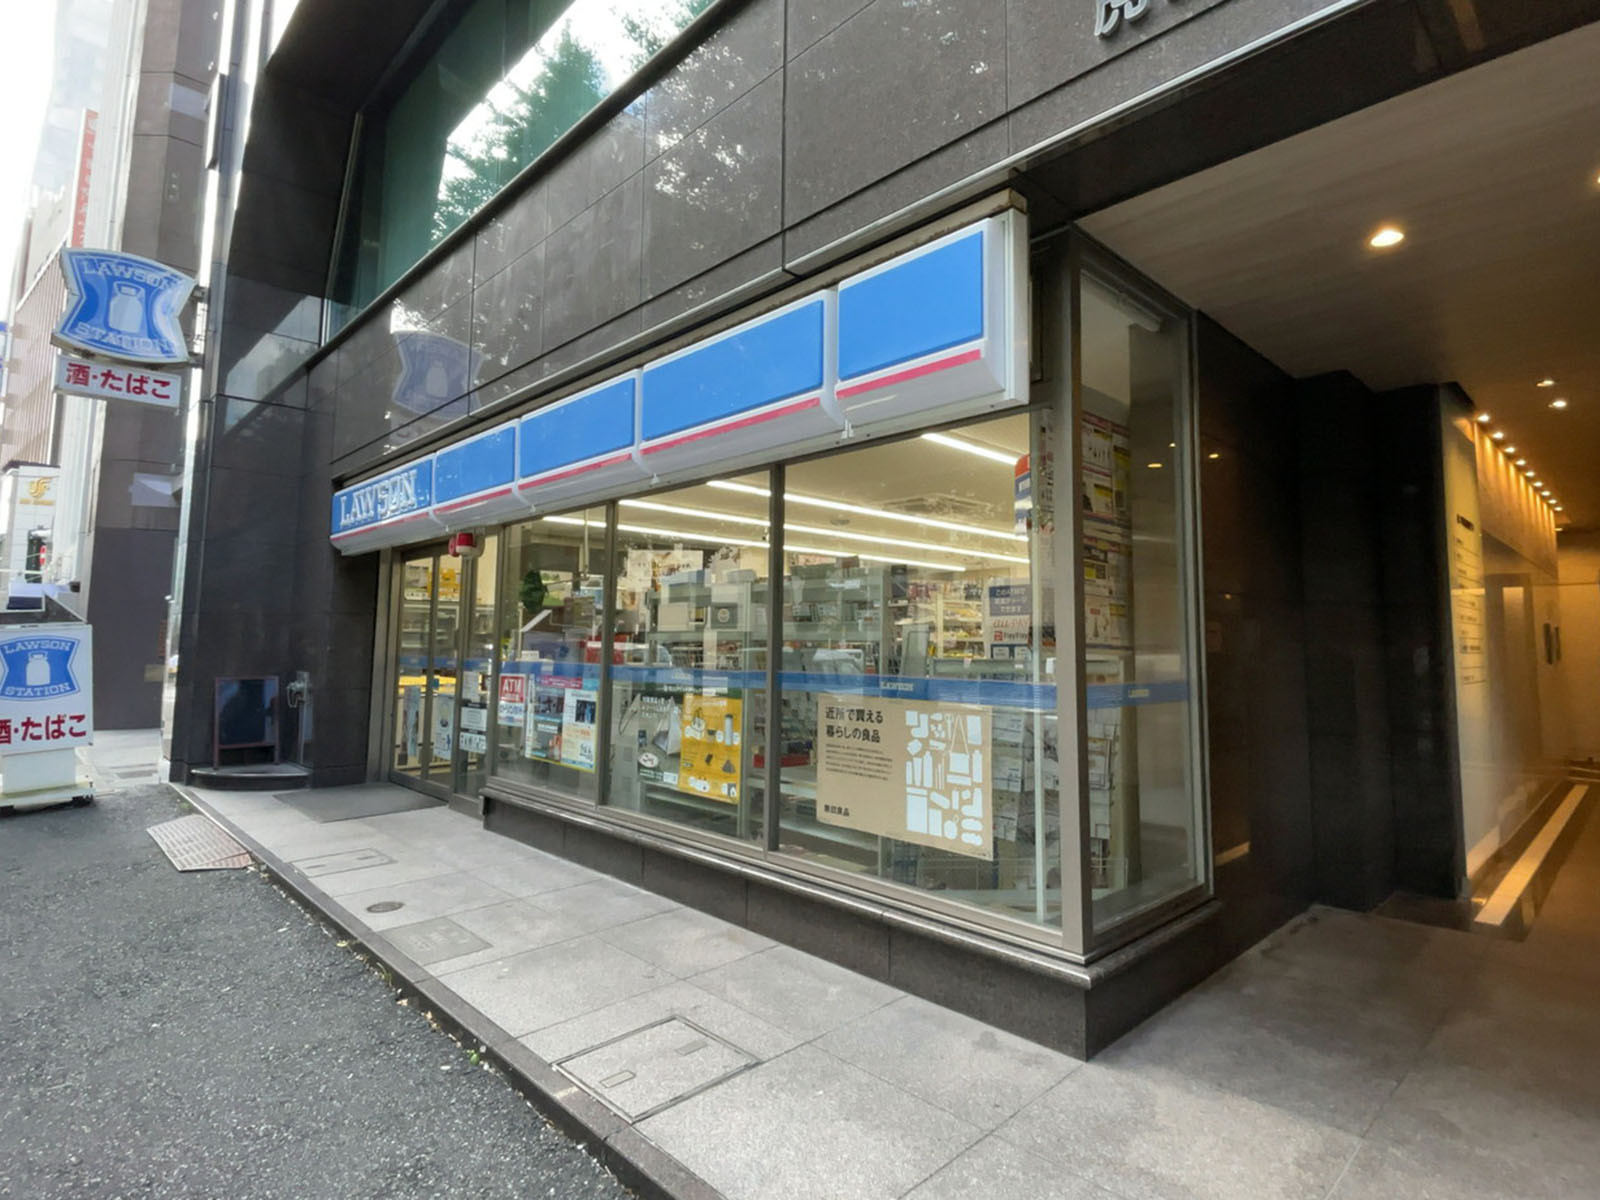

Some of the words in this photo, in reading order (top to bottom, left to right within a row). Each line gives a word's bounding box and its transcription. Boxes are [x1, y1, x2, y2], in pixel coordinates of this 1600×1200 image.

[82, 257, 185, 290] LAWSON
[74, 323, 175, 354] STATION
[340, 469, 417, 526] LAWSON
[4, 640, 72, 654] LAWSON
[5, 683, 71, 696] STATION
[502, 678, 522, 693] ATM
[825, 706, 884, 724] 近所で買える
[826, 725, 881, 743] 暮らしの良品
